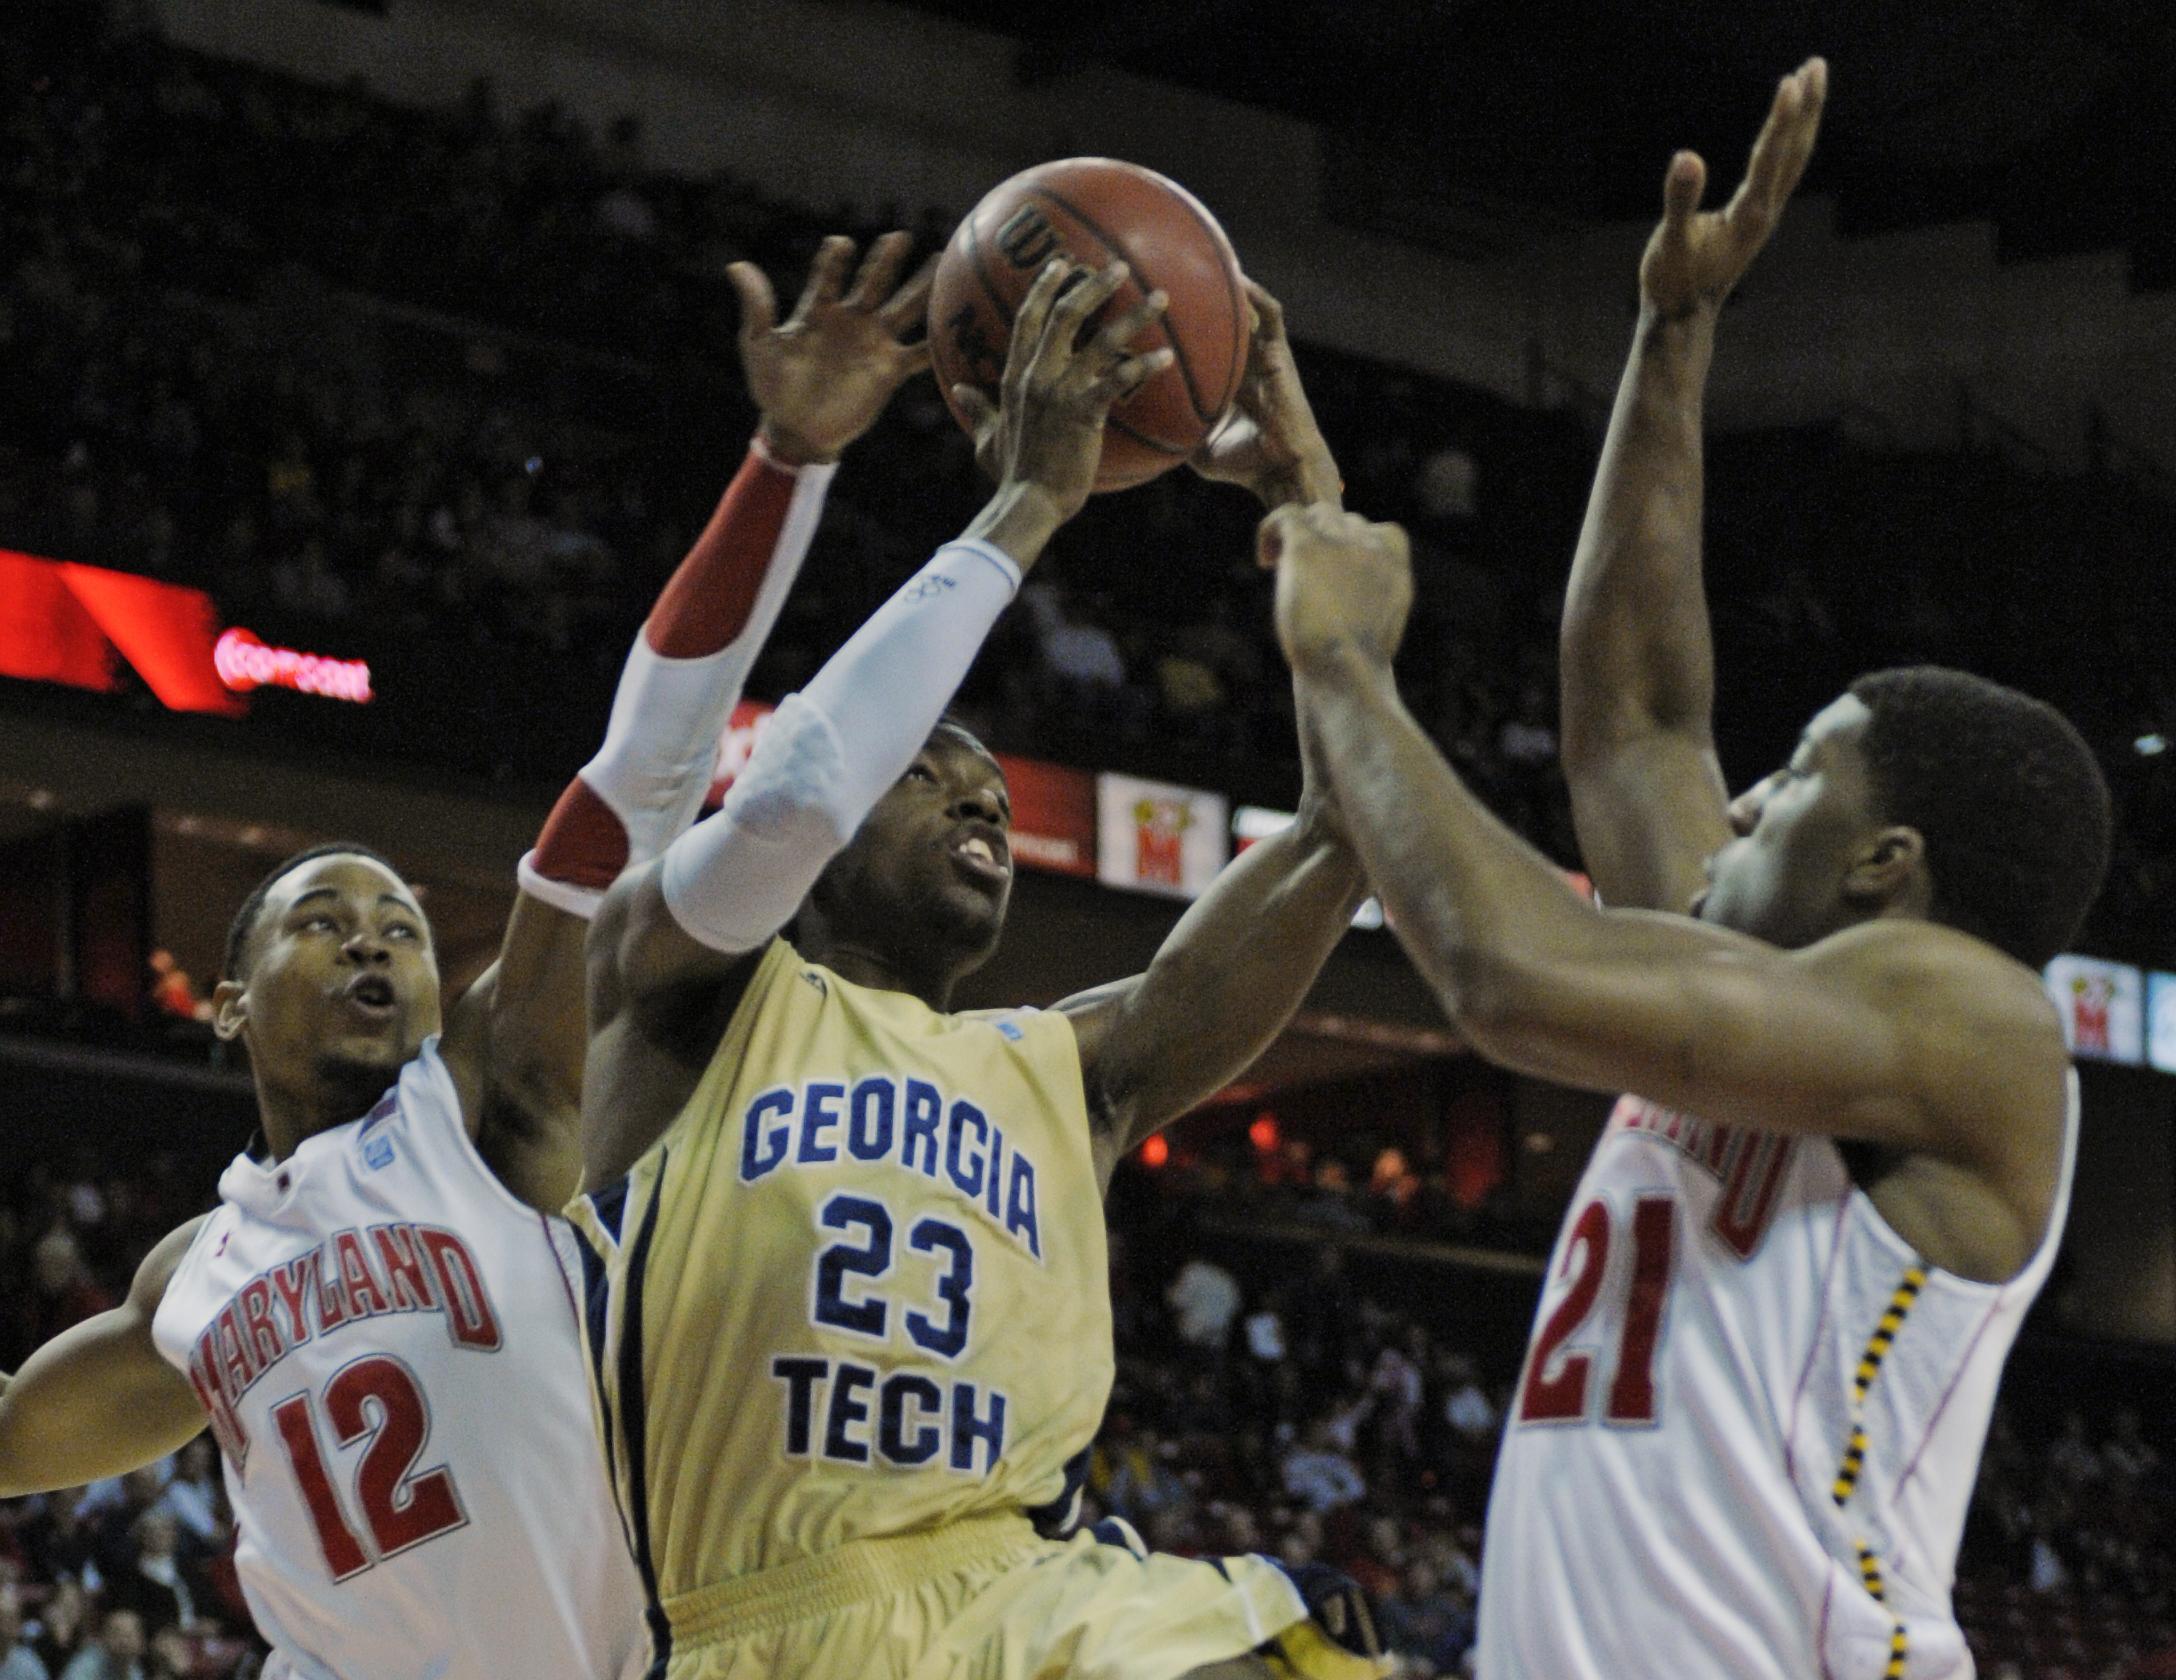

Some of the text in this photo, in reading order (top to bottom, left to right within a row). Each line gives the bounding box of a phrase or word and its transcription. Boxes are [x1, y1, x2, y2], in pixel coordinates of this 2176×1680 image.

[738, 1074, 1042, 1262] GEORGIA
[811, 1191, 974, 1363] 23
[1519, 1190, 1675, 1430] 21
[270, 1353, 471, 1585] 12
[771, 1355, 1007, 1475] TECH
